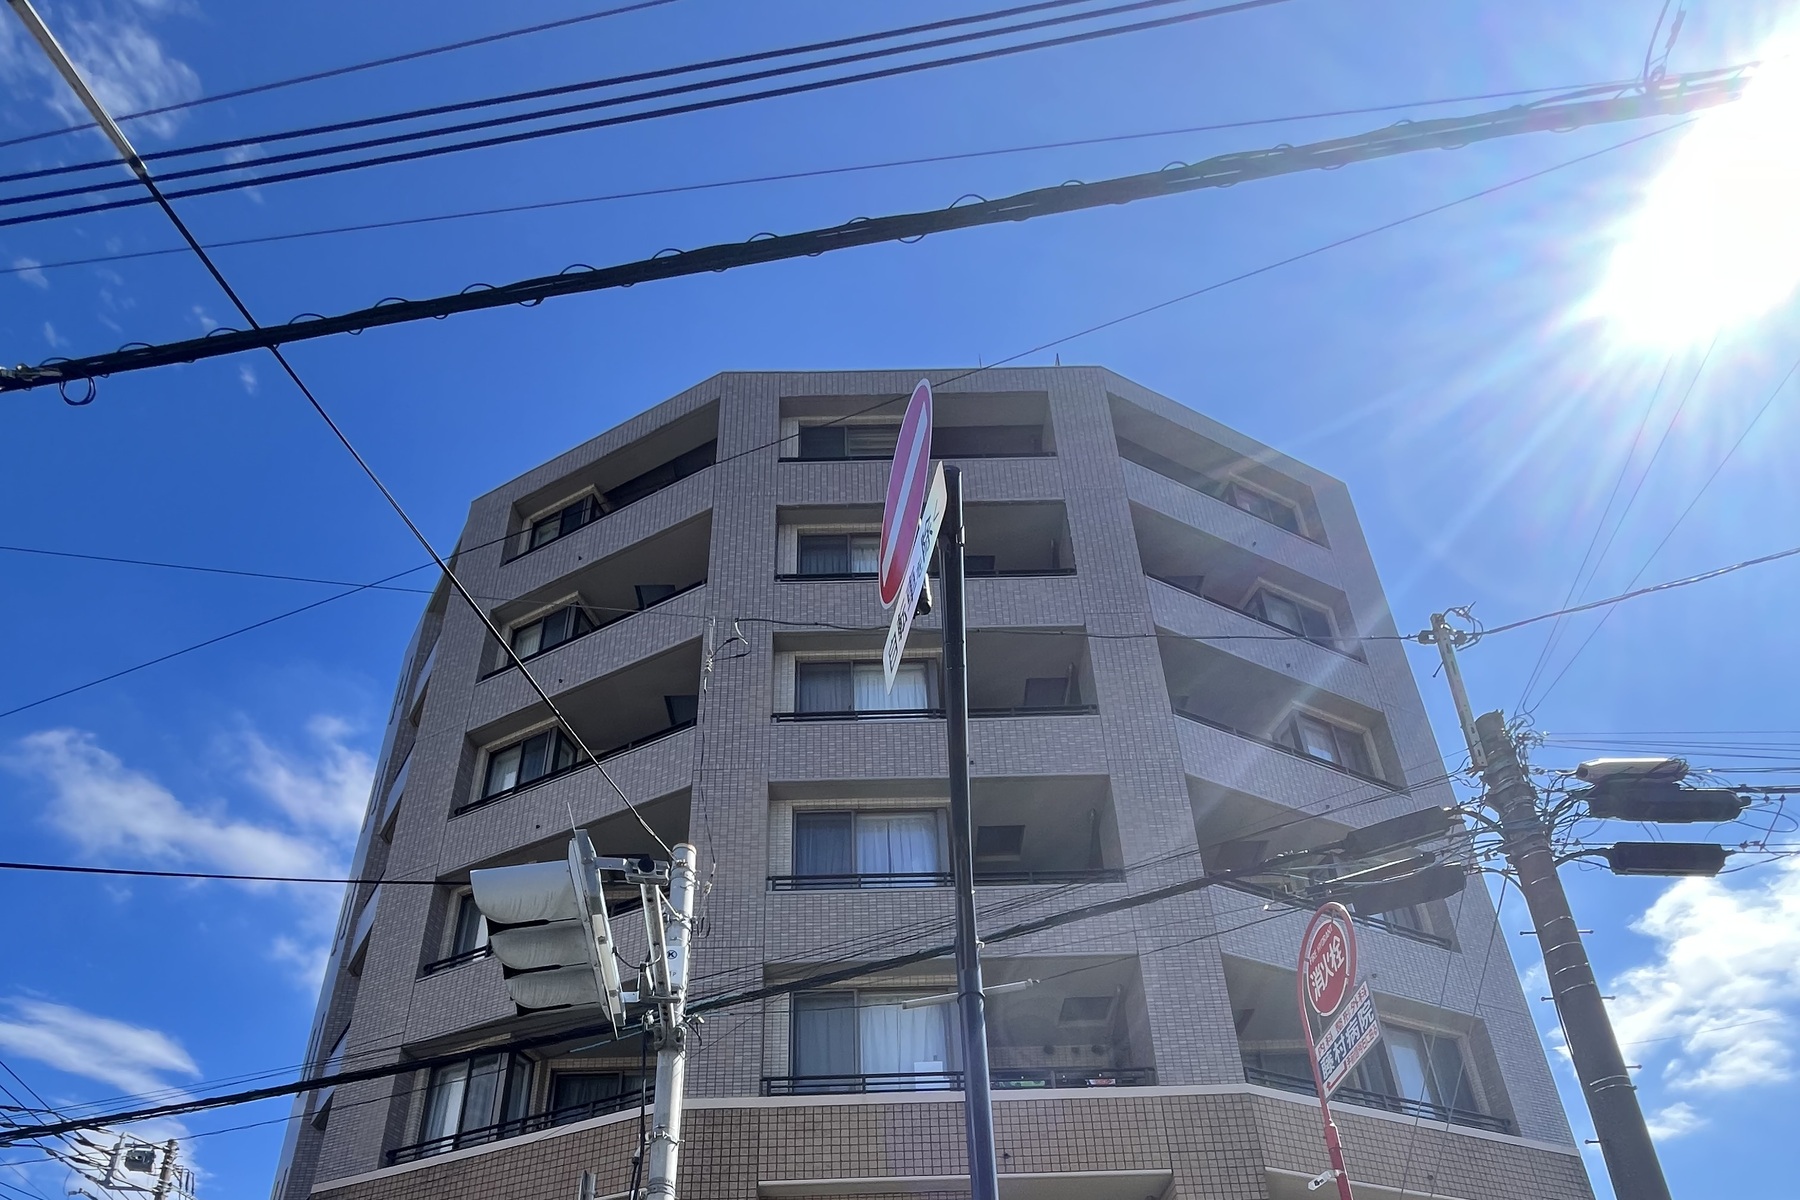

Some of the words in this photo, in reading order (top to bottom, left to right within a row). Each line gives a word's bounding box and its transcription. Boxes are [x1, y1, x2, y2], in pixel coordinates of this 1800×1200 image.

[888, 498, 939, 672] 自転車を除く
[1310, 935, 1345, 1001] 消火栓
[1317, 1033, 1333, 1056] 内科
[1335, 986, 1367, 1033] 整形外科
[1320, 1000, 1375, 1081] 藤村病院
